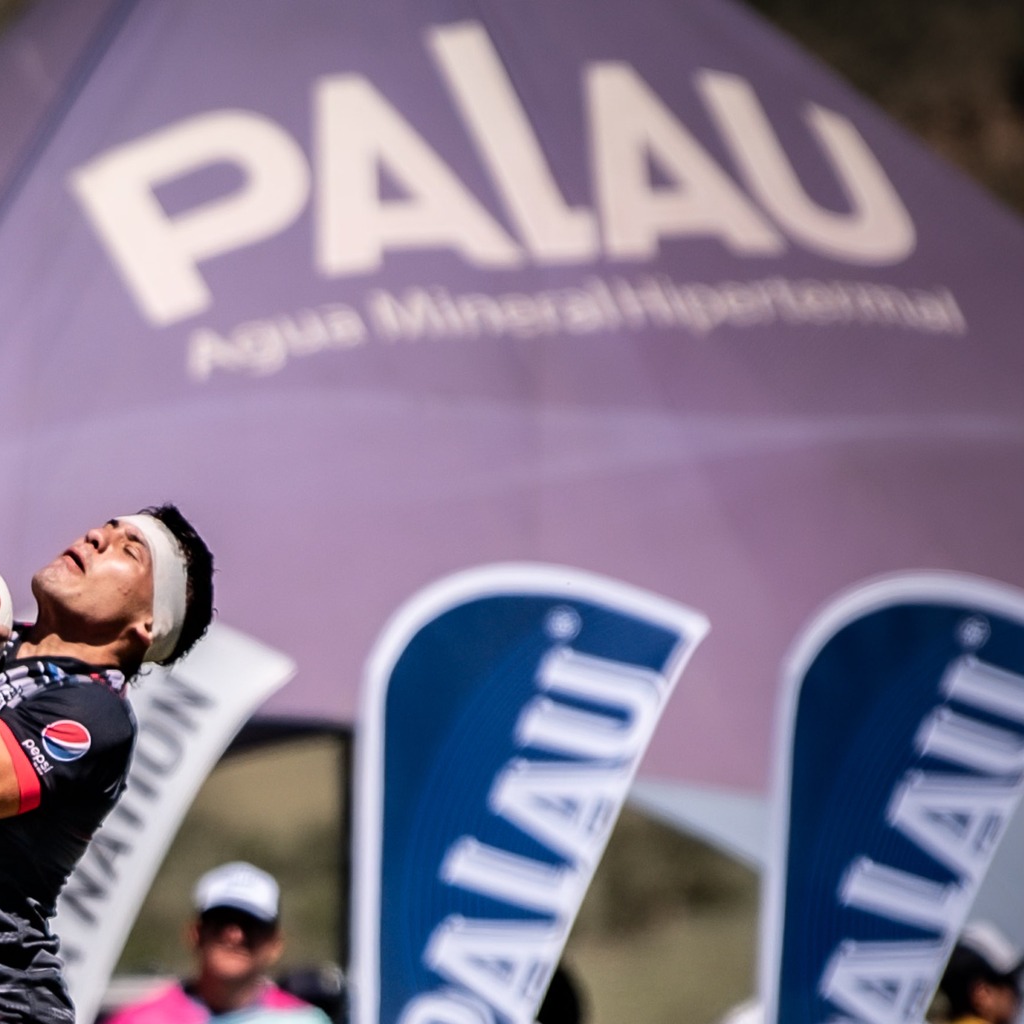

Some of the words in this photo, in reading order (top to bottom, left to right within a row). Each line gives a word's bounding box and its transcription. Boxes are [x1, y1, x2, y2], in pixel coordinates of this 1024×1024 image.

[69, 20, 916, 326] PALAU
[188, 304, 367, 381] Agua
[371, 277, 612, 341] Mineral
[613, 275, 967, 337] Hipertermal
[21, 738, 54, 773] pepsi
